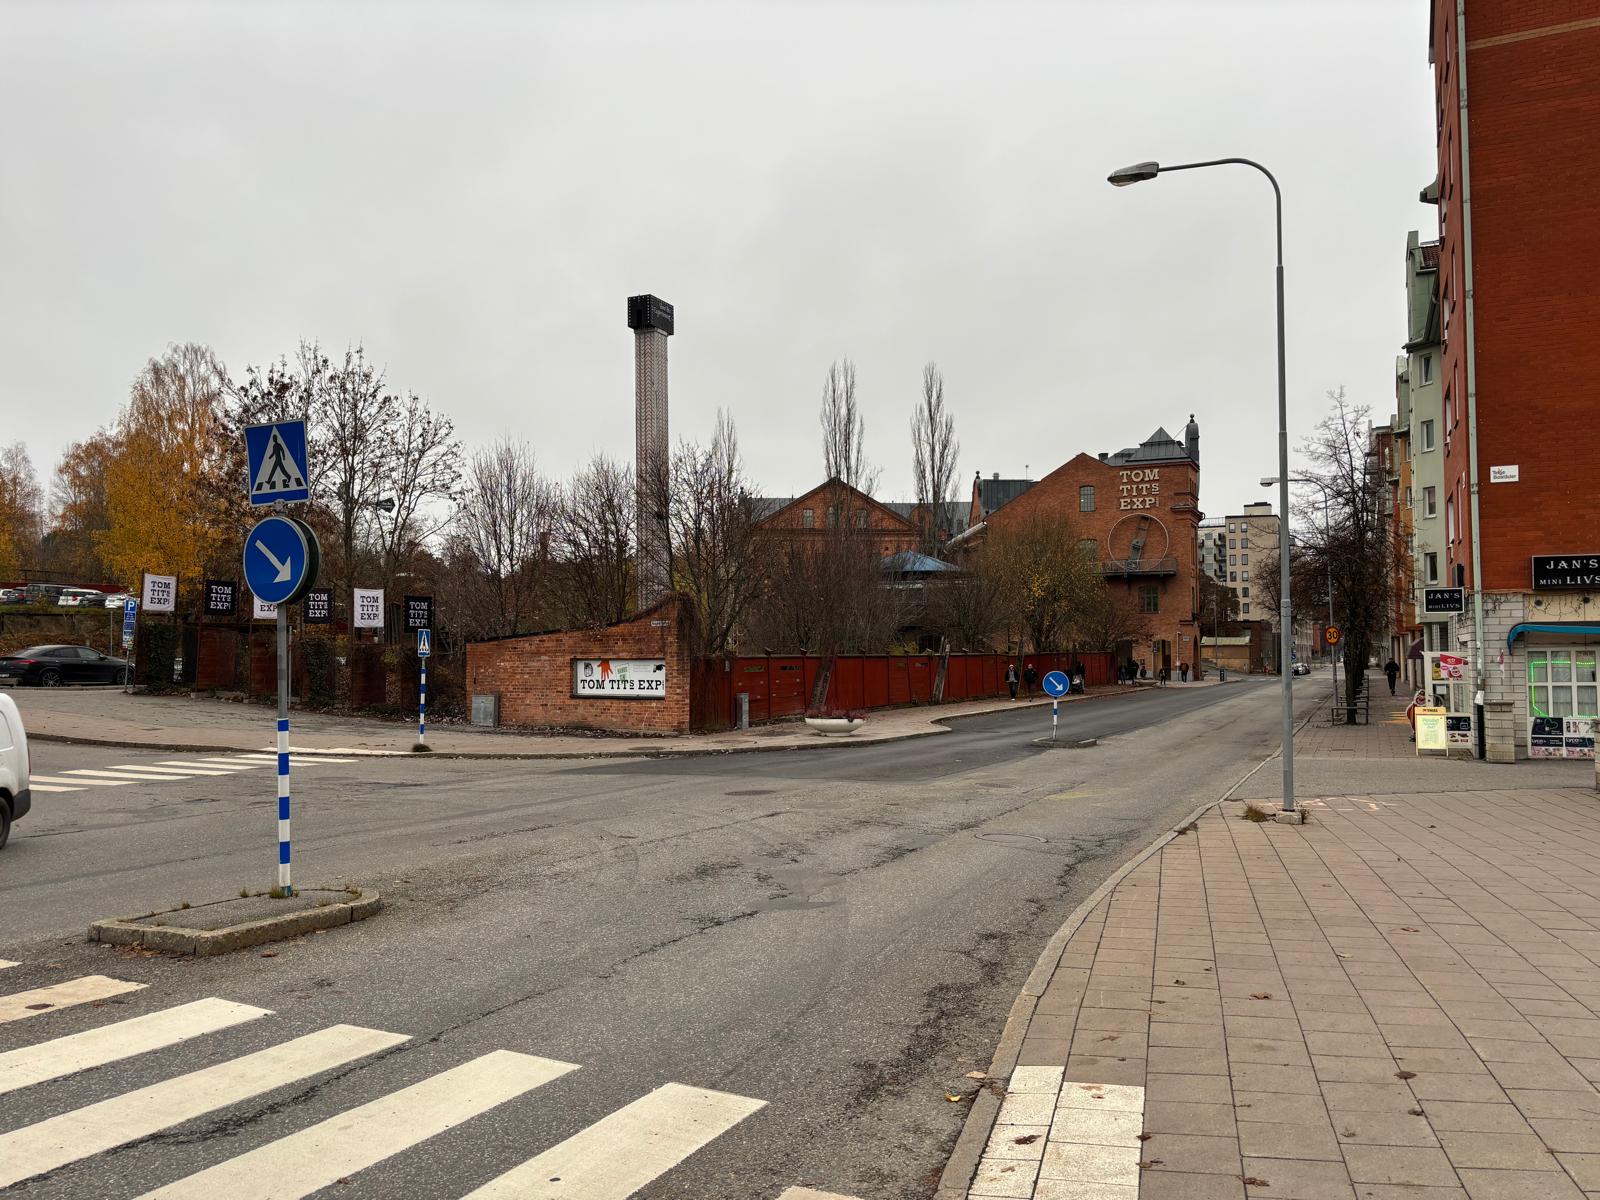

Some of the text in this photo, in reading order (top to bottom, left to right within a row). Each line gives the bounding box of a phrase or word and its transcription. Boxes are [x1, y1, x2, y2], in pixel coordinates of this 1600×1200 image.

[1120, 469, 1159, 482] TOM
[1546, 559, 1599, 569] JAN'S
[1566, 575, 1600, 585] LIVS
[150, 581, 171, 589] TOM
[210, 585, 232, 594] TOM
[309, 593, 328, 601] TOM
[128, 601, 135, 610] P
[409, 602, 428, 610] TOM
[1328, 631, 1337, 640] 30
[581, 679, 605, 689] TOM
